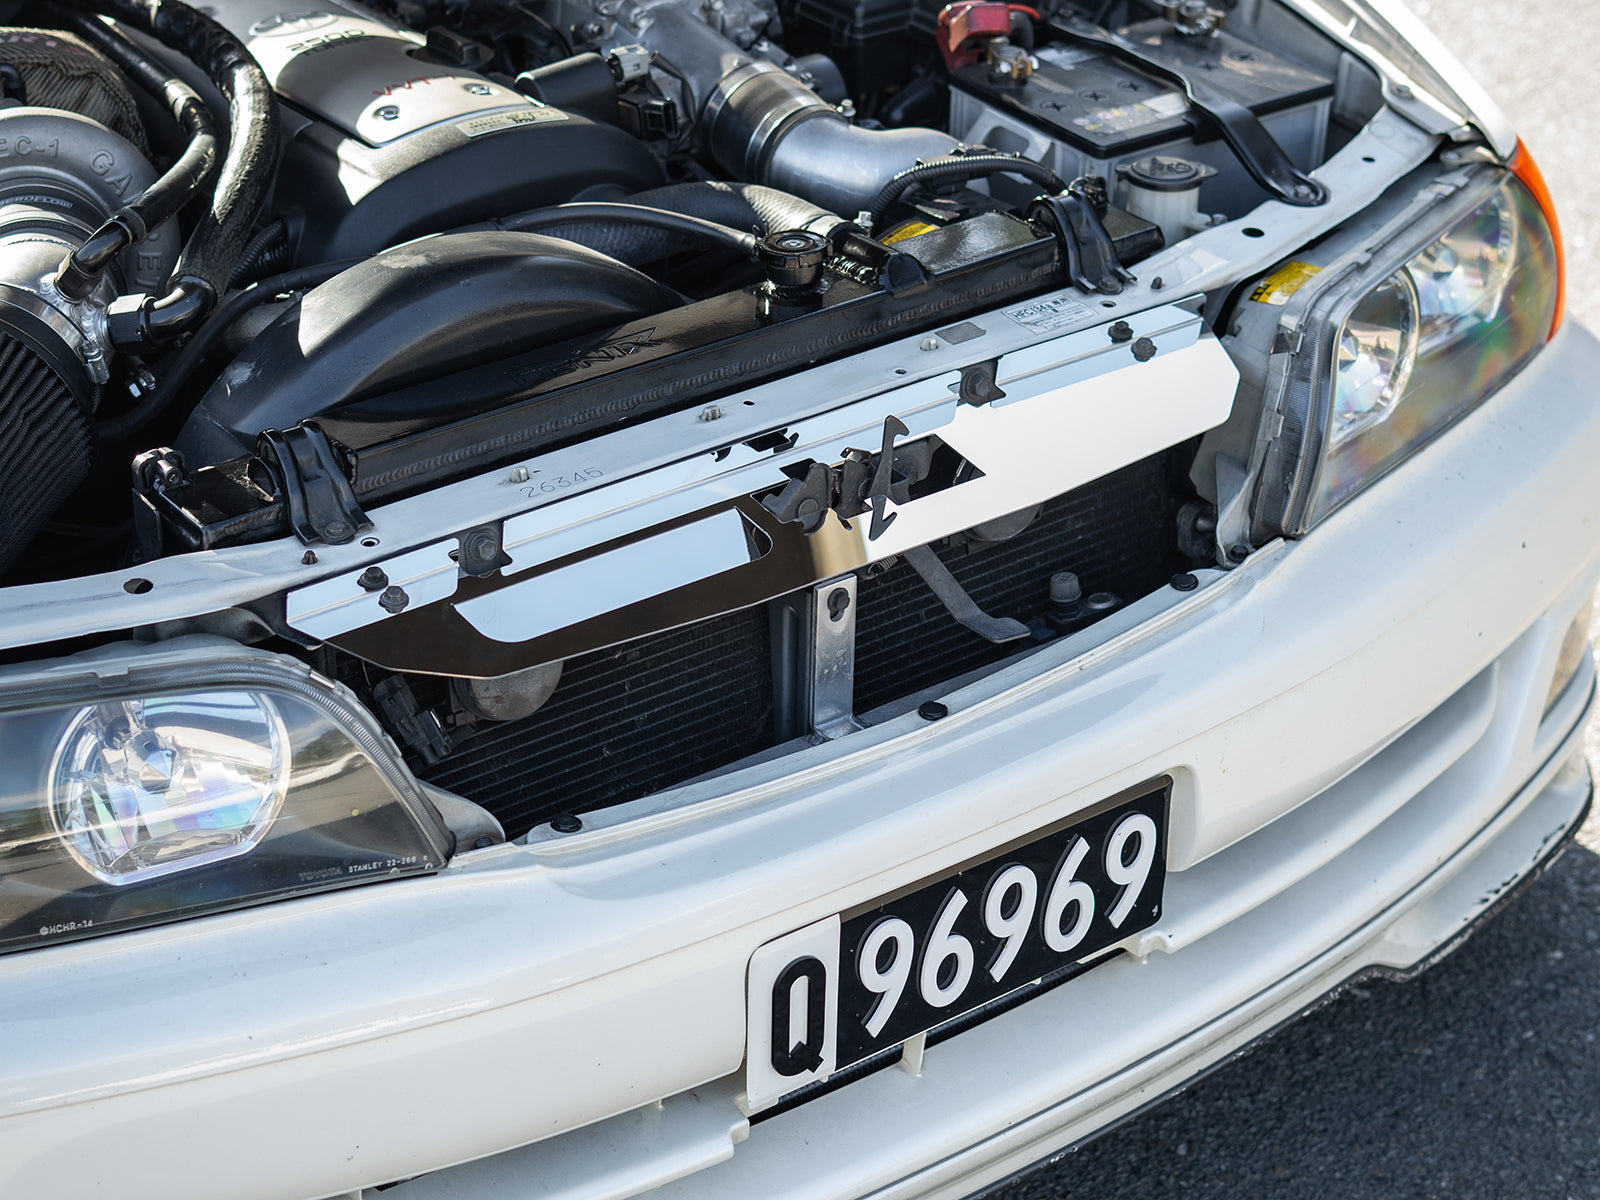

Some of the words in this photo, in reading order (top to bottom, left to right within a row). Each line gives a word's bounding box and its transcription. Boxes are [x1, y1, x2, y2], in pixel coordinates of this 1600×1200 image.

[348, 861, 384, 873] STANLEY
[771, 955, 827, 1077] Q
[856, 811, 1157, 1039] 96969
